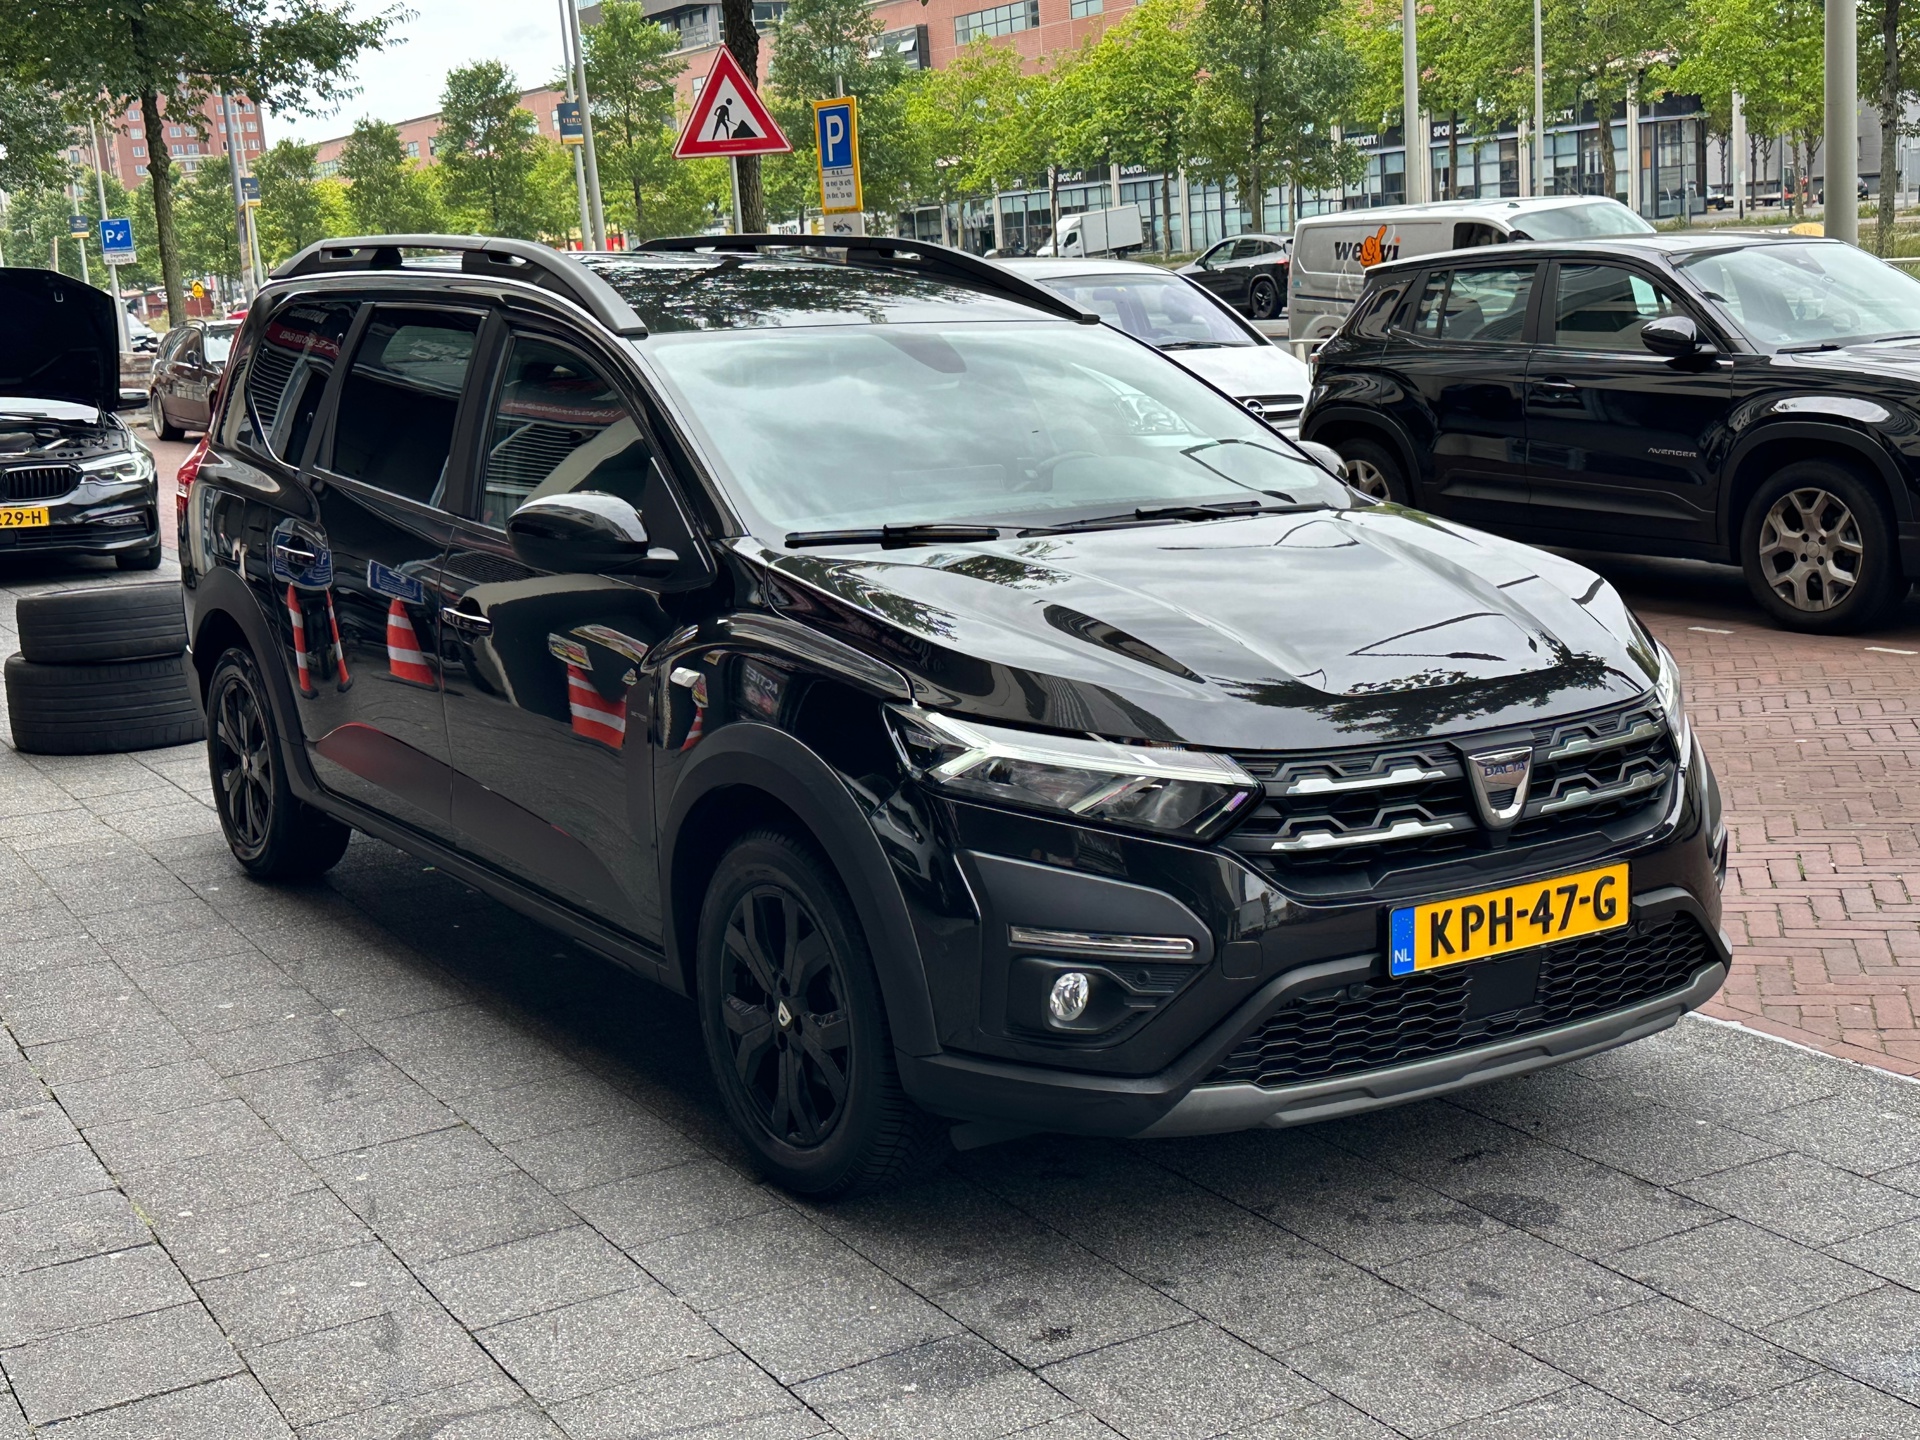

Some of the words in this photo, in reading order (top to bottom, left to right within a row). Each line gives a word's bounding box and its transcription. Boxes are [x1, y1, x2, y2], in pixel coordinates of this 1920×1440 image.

[826, 115, 844, 162] P
[105, 229, 115, 244] P
[1647, 447, 1697, 458] AVENGER
[0, 510, 42, 526] 29-H
[1484, 761, 1526, 777] DACIA
[1430, 875, 1617, 958] KPH-47-G
[1394, 948, 1412, 964] NL
